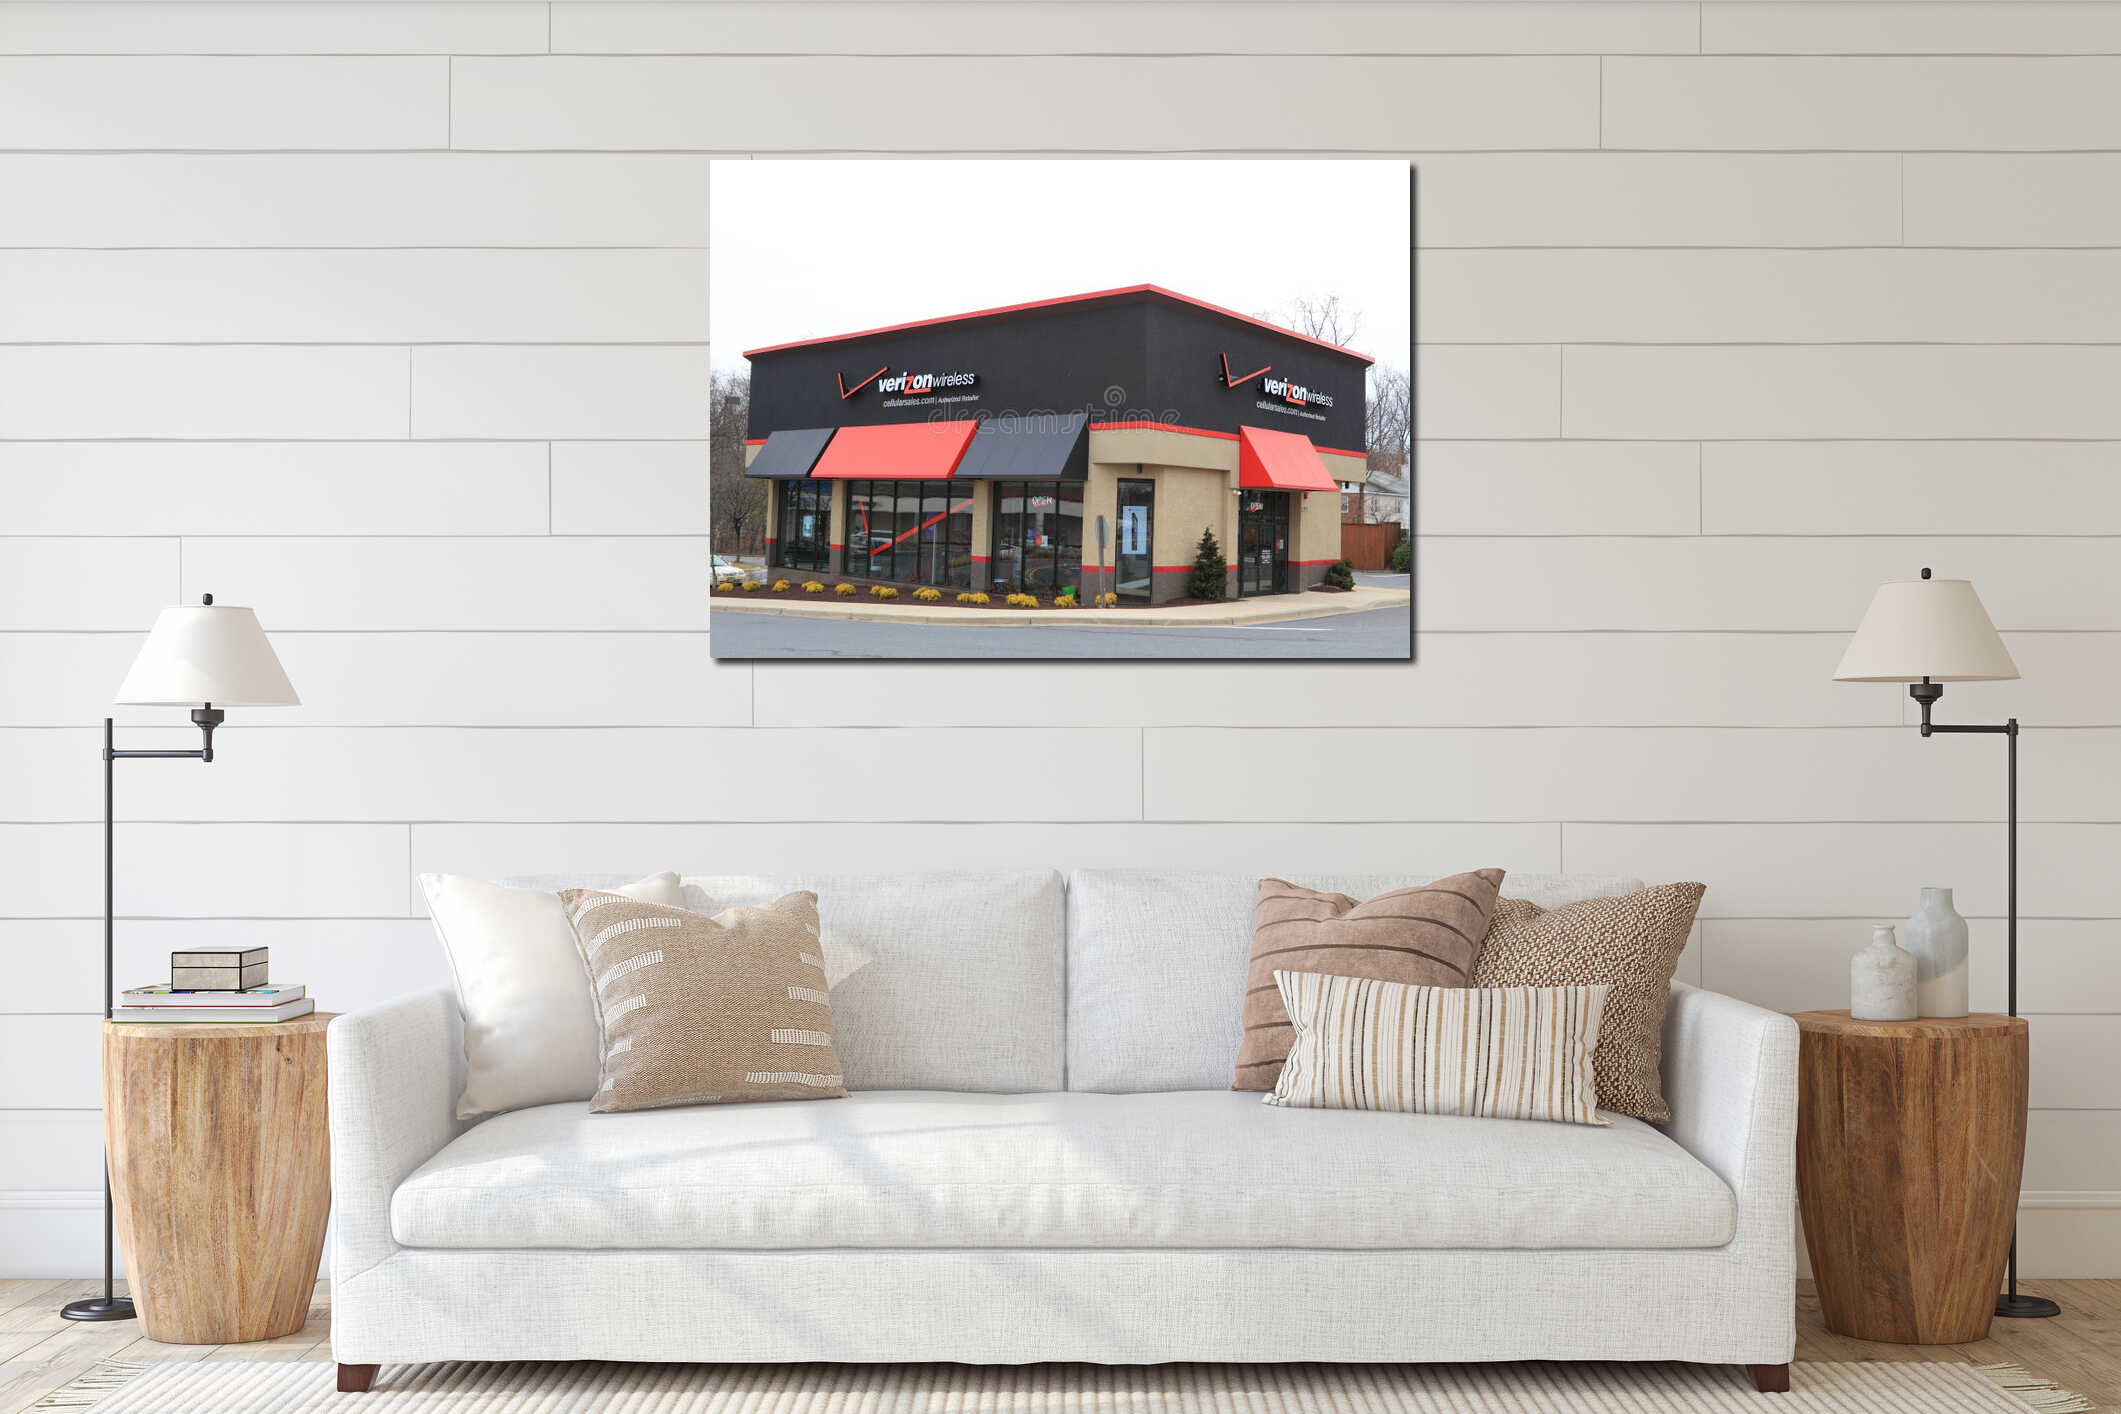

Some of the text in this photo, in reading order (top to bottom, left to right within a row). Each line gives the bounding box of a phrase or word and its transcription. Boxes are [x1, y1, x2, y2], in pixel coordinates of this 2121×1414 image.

[879, 372, 975, 394] verizon wireless
[1264, 377, 1334, 407] verizon wireless
